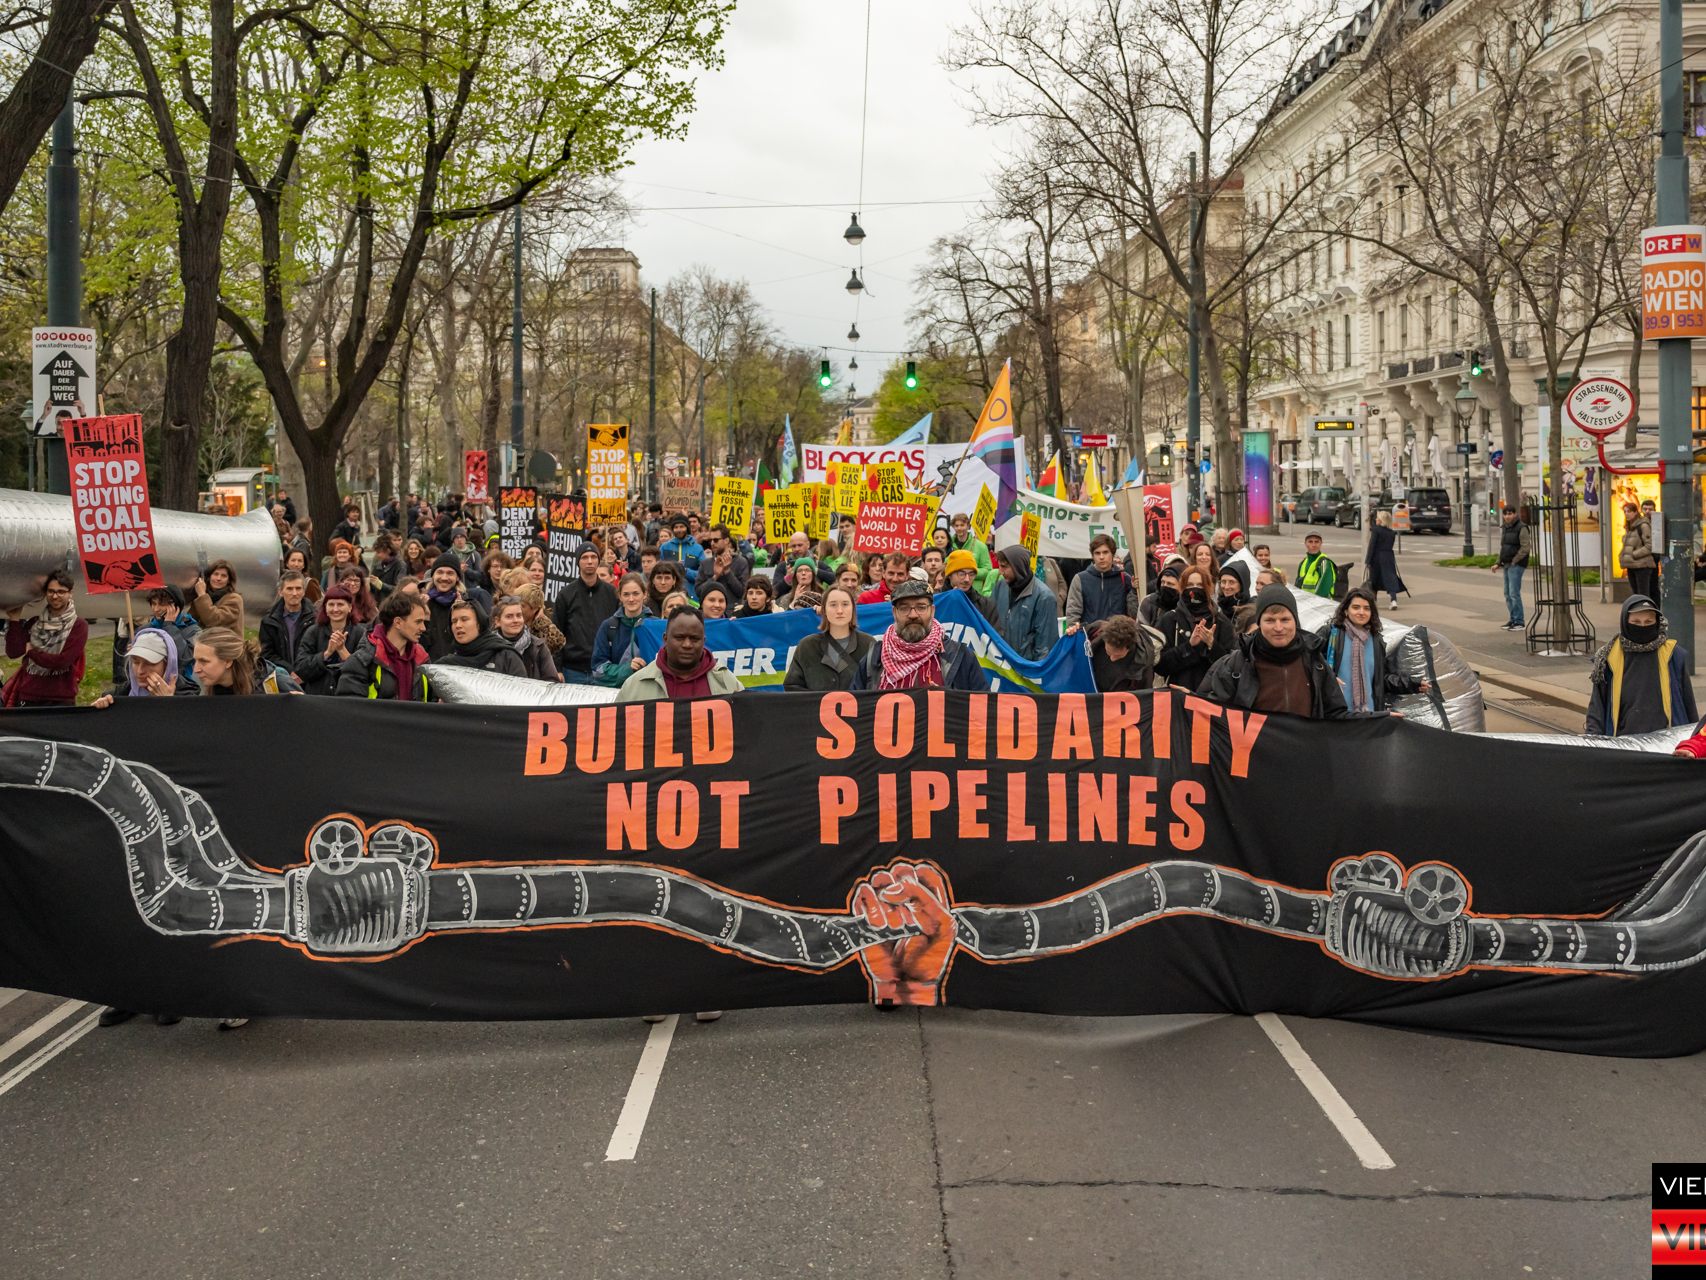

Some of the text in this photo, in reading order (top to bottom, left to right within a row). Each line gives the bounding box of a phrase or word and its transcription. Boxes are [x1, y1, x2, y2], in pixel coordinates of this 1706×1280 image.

[1646, 238, 1683, 252] ORF
[1644, 269, 1703, 291] RADIO
[1645, 290, 1704, 313] WIEN
[54, 360, 74, 369] AUF
[52, 369, 75, 377] DAUER
[53, 392, 75, 401] WEG
[1575, 385, 1627, 403] STRASSENBAHN
[1577, 410, 1624, 426] HALTESTELLE
[1582, 440, 1588, 448] 2
[590, 449, 626, 462] STOP
[804, 449, 925, 472] BLOCK GAS
[75, 460, 140, 486] STOP
[590, 463, 626, 474] BUYING
[842, 466, 860, 474] CLEAN
[877, 468, 896, 477] STOP
[590, 475, 626, 487] OIL
[727, 480, 742, 489] IT'S
[841, 473, 859, 486] GAS
[878, 475, 903, 485] FOSSIL
[76, 485, 145, 508] BUYING
[590, 488, 626, 499] BONDS
[776, 494, 790, 502] IT'S
[881, 484, 904, 503] GAS
[915, 496, 928, 504] IT'S
[721, 496, 745, 507] FOSSIL
[841, 495, 854, 508] LIE
[79, 505, 148, 532] COAL
[502, 507, 535, 520] DENY
[719, 505, 744, 526] GAS
[772, 510, 796, 518] FOSSIL
[862, 504, 921, 521] ANOTHER
[506, 519, 529, 527] DIRTY
[773, 518, 797, 538] GAS
[860, 520, 916, 535] WORLD IS
[502, 526, 534, 536] DEBT
[1048, 524, 1068, 540] for
[82, 530, 151, 552] BONDS
[549, 530, 583, 553] DEFUND
[858, 534, 920, 551] POSSIBLE
[711, 647, 777, 677] TER
[524, 690, 1268, 779] BUILD SOLIDARITY
[606, 769, 1206, 851] NOT PIPELINES
